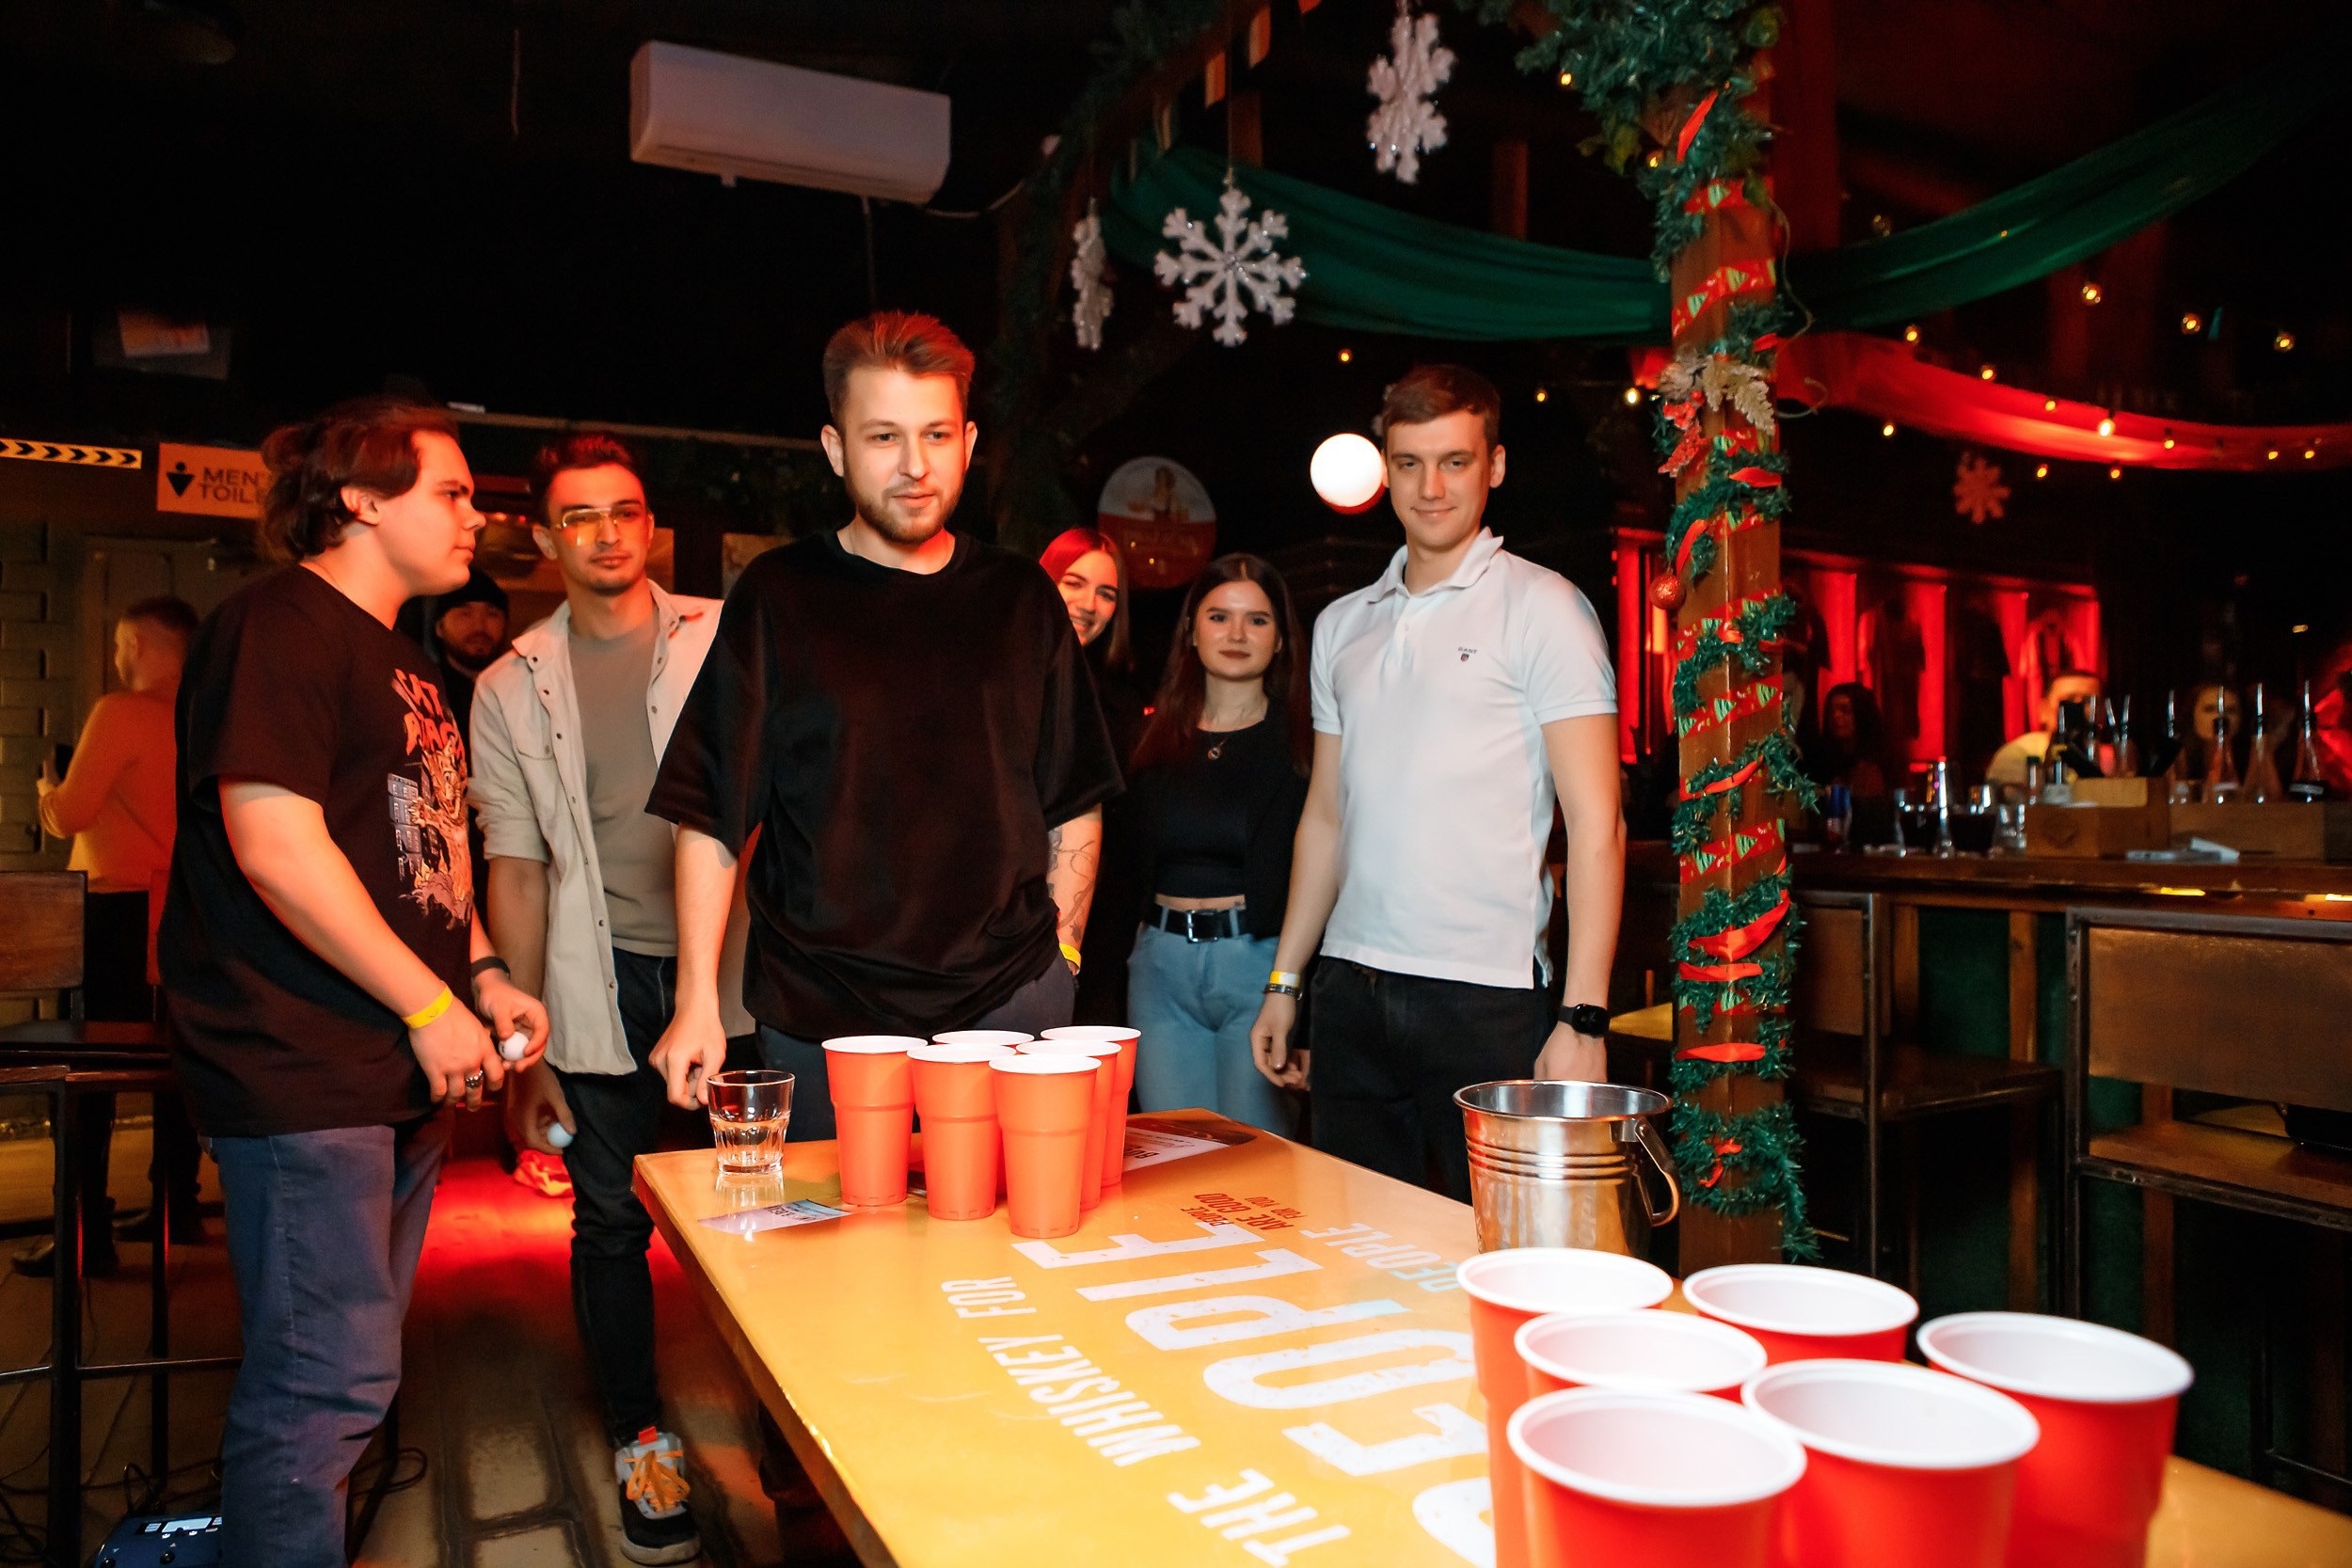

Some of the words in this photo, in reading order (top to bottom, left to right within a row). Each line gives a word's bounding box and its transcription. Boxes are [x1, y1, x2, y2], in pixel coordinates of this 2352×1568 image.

[1194, 1193, 1251, 1214] GOOD
[1244, 1196, 1279, 1209] YOU
[1180, 1205, 1235, 1227] PEOPLE
[1236, 1212, 1295, 1230] ARE
[1270, 1207, 1309, 1220] FOR
[941, 1275, 1038, 1319] FOR
[977, 1334, 1202, 1467] WHISKEY
[1167, 1468, 1352, 1568] THE
